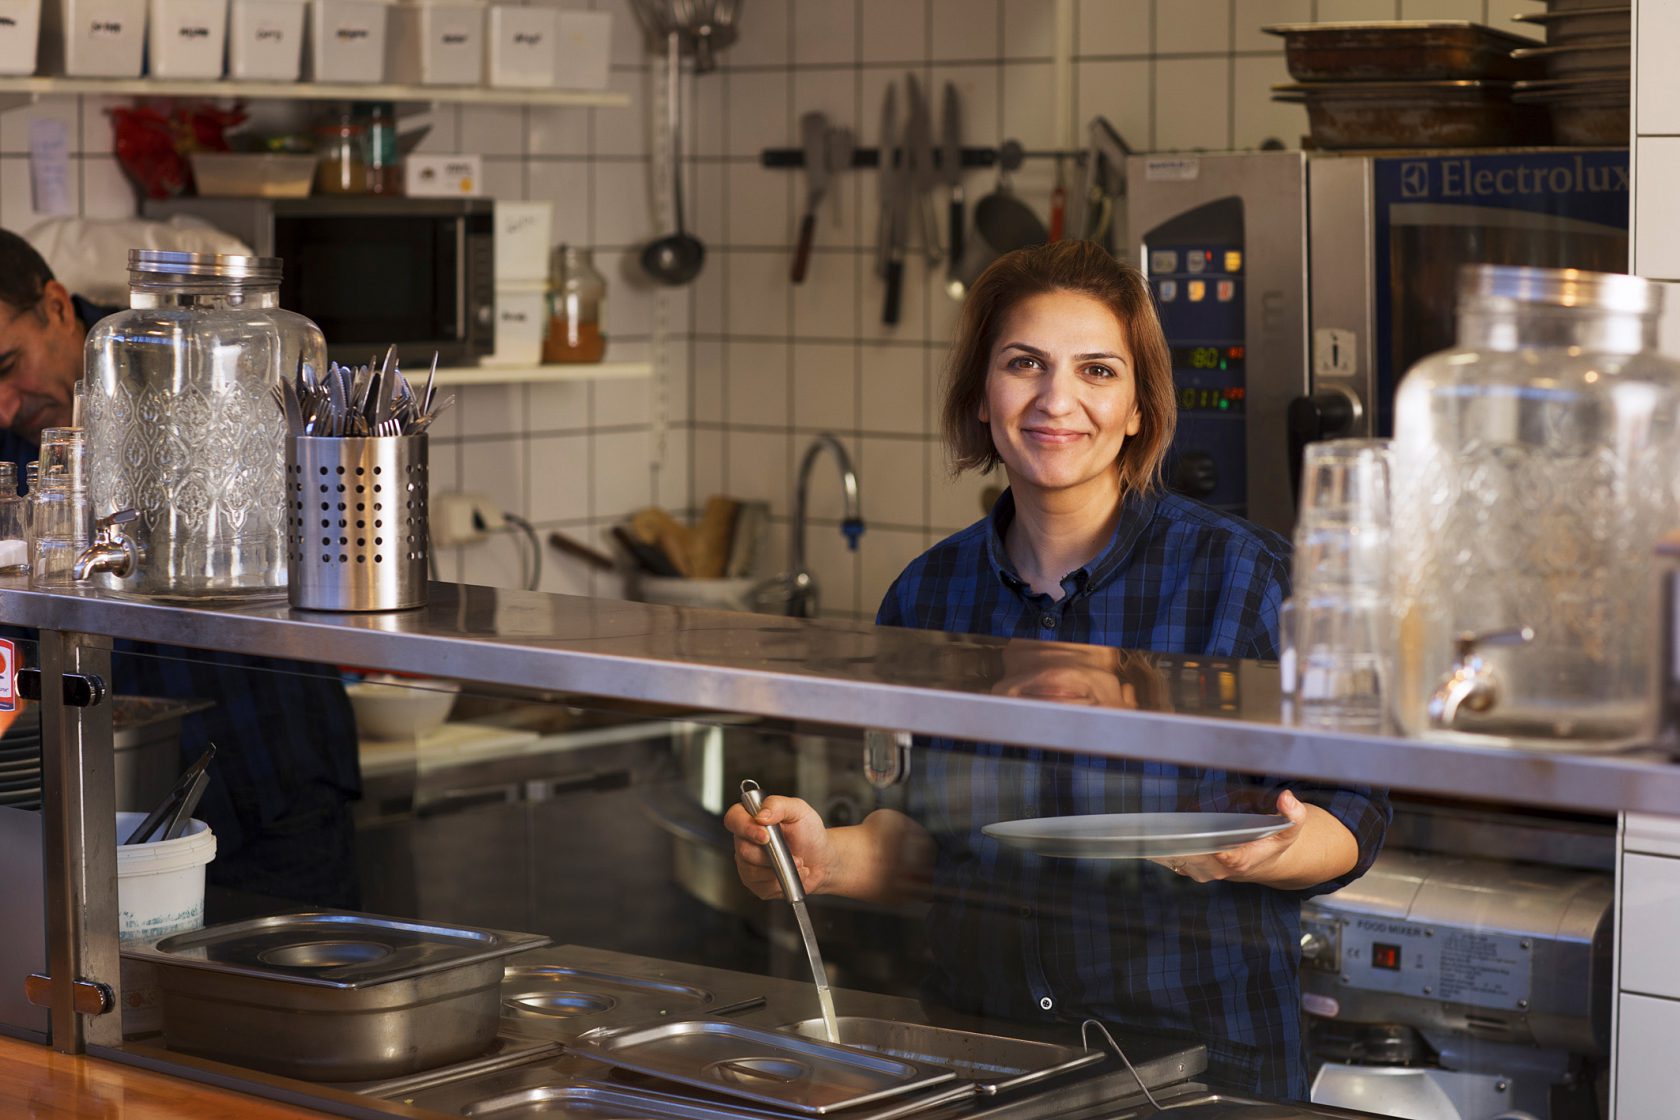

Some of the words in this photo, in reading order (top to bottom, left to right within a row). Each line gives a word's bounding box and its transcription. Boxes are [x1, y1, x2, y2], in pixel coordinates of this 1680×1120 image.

[1441, 155, 1630, 198] Electrolux
[1357, 919, 1386, 933] FOOD
[1388, 923, 1421, 937] MIXER
